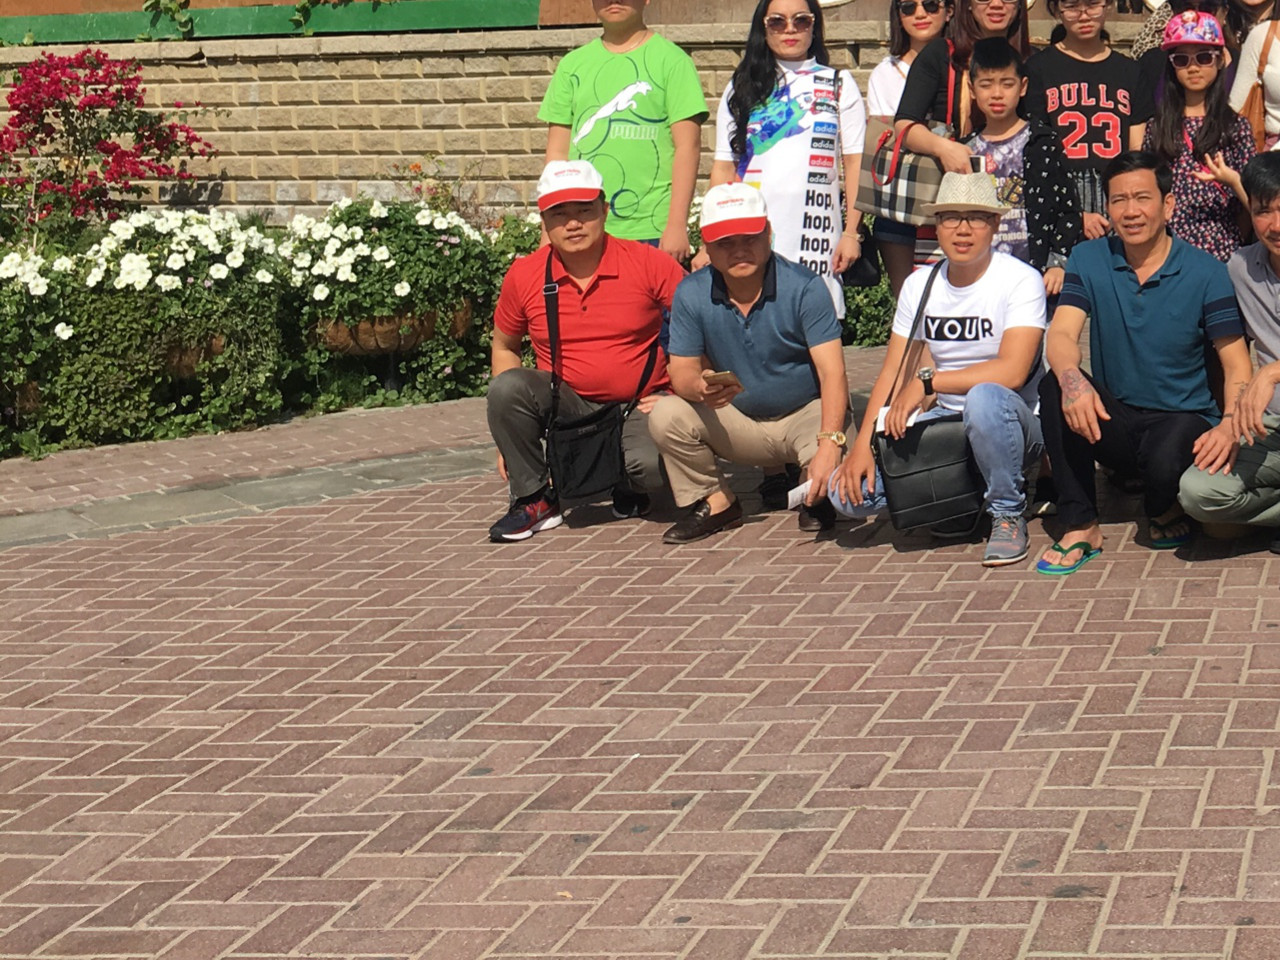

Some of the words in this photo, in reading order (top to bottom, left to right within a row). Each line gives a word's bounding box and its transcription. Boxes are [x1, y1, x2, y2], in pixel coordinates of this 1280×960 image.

[1046, 83, 1132, 115] BULLS
[610, 124, 659, 140] PUMA
[1057, 111, 1122, 159] 23
[805, 189, 834, 211] Hop,
[803, 211, 834, 233] hop,
[800, 234, 833, 255] hop,
[926, 317, 994, 340] YOUR
